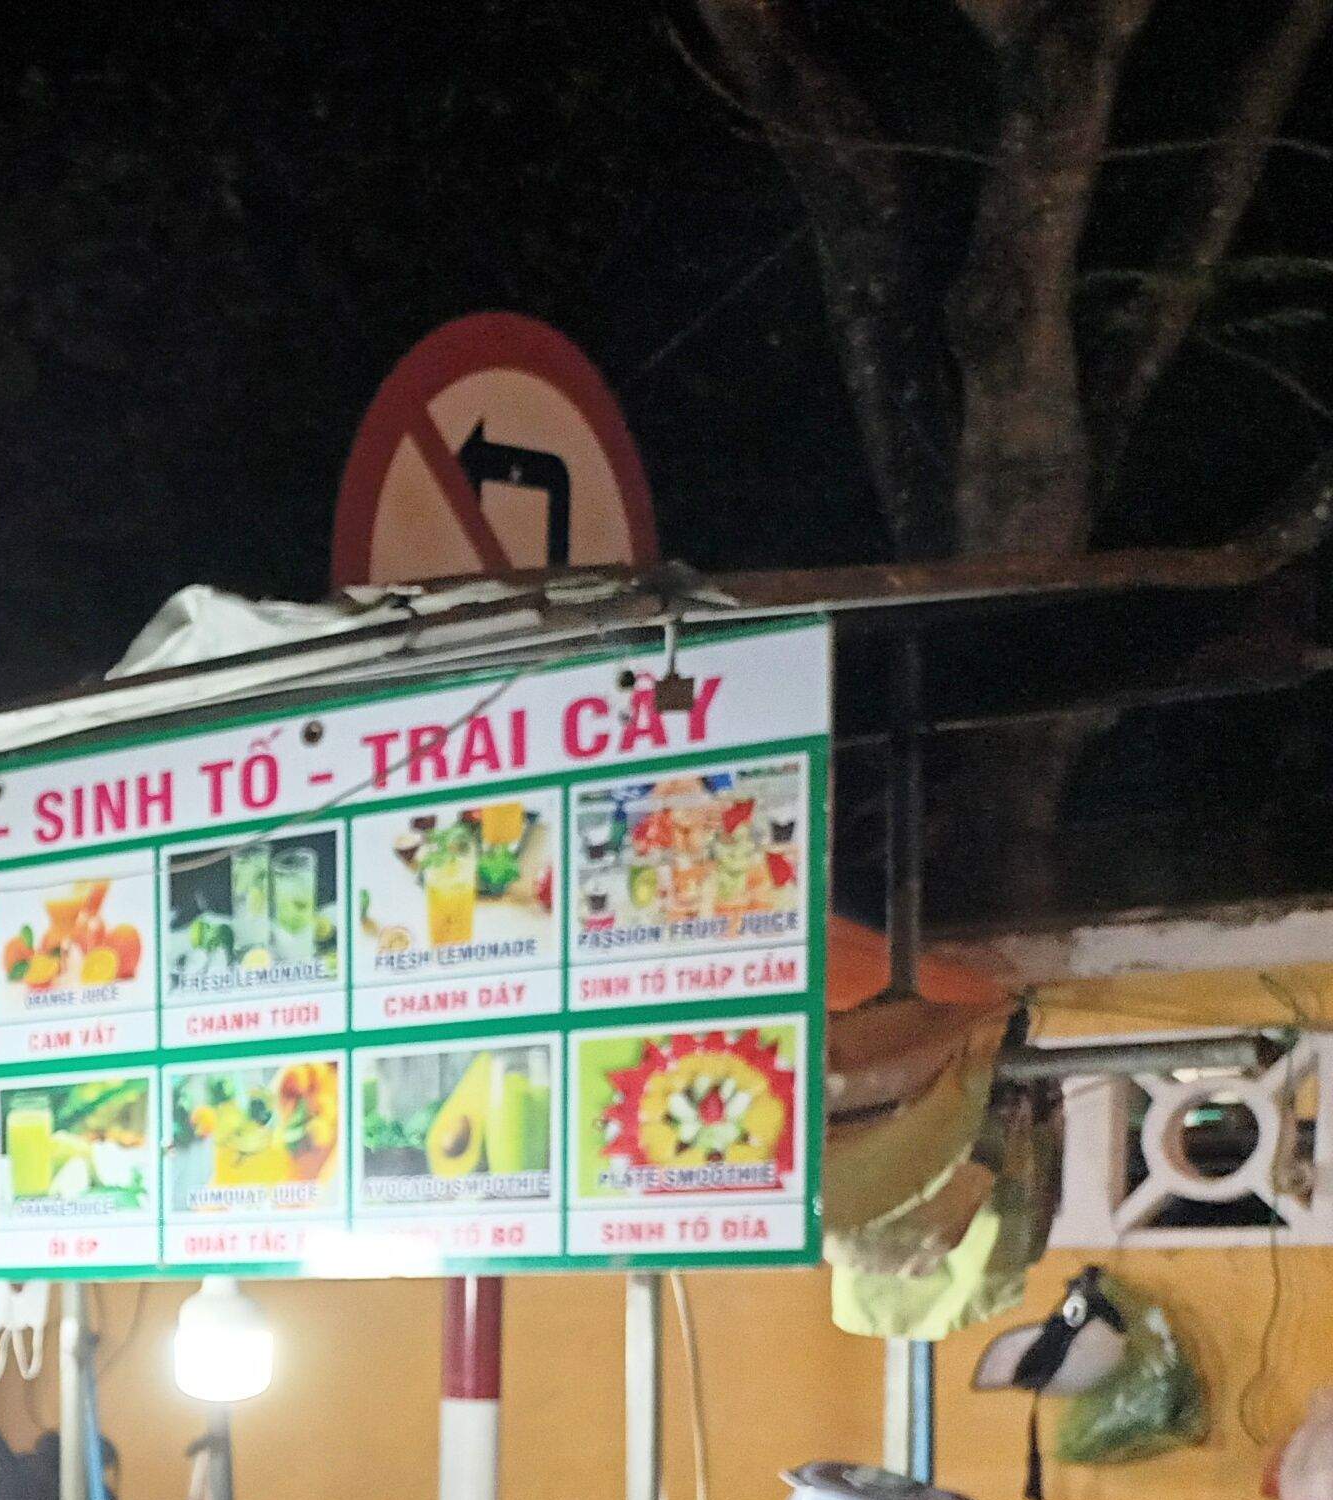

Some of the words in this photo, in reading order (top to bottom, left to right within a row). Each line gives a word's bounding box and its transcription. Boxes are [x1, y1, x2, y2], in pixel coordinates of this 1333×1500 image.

[33, 770, 174, 845] SINH
[199, 728, 280, 817] TỐ
[307, 772, 335, 787] -
[577, 921, 663, 949] PASSION
[737, 910, 800, 936] JUICE
[374, 949, 430, 971] FRESH
[435, 937, 538, 965] LEMONADE
[579, 974, 630, 1001] SINH
[383, 988, 469, 1019] CHANH
[186, 1009, 260, 1037] CHANH
[601, 1219, 666, 1244] SINH
